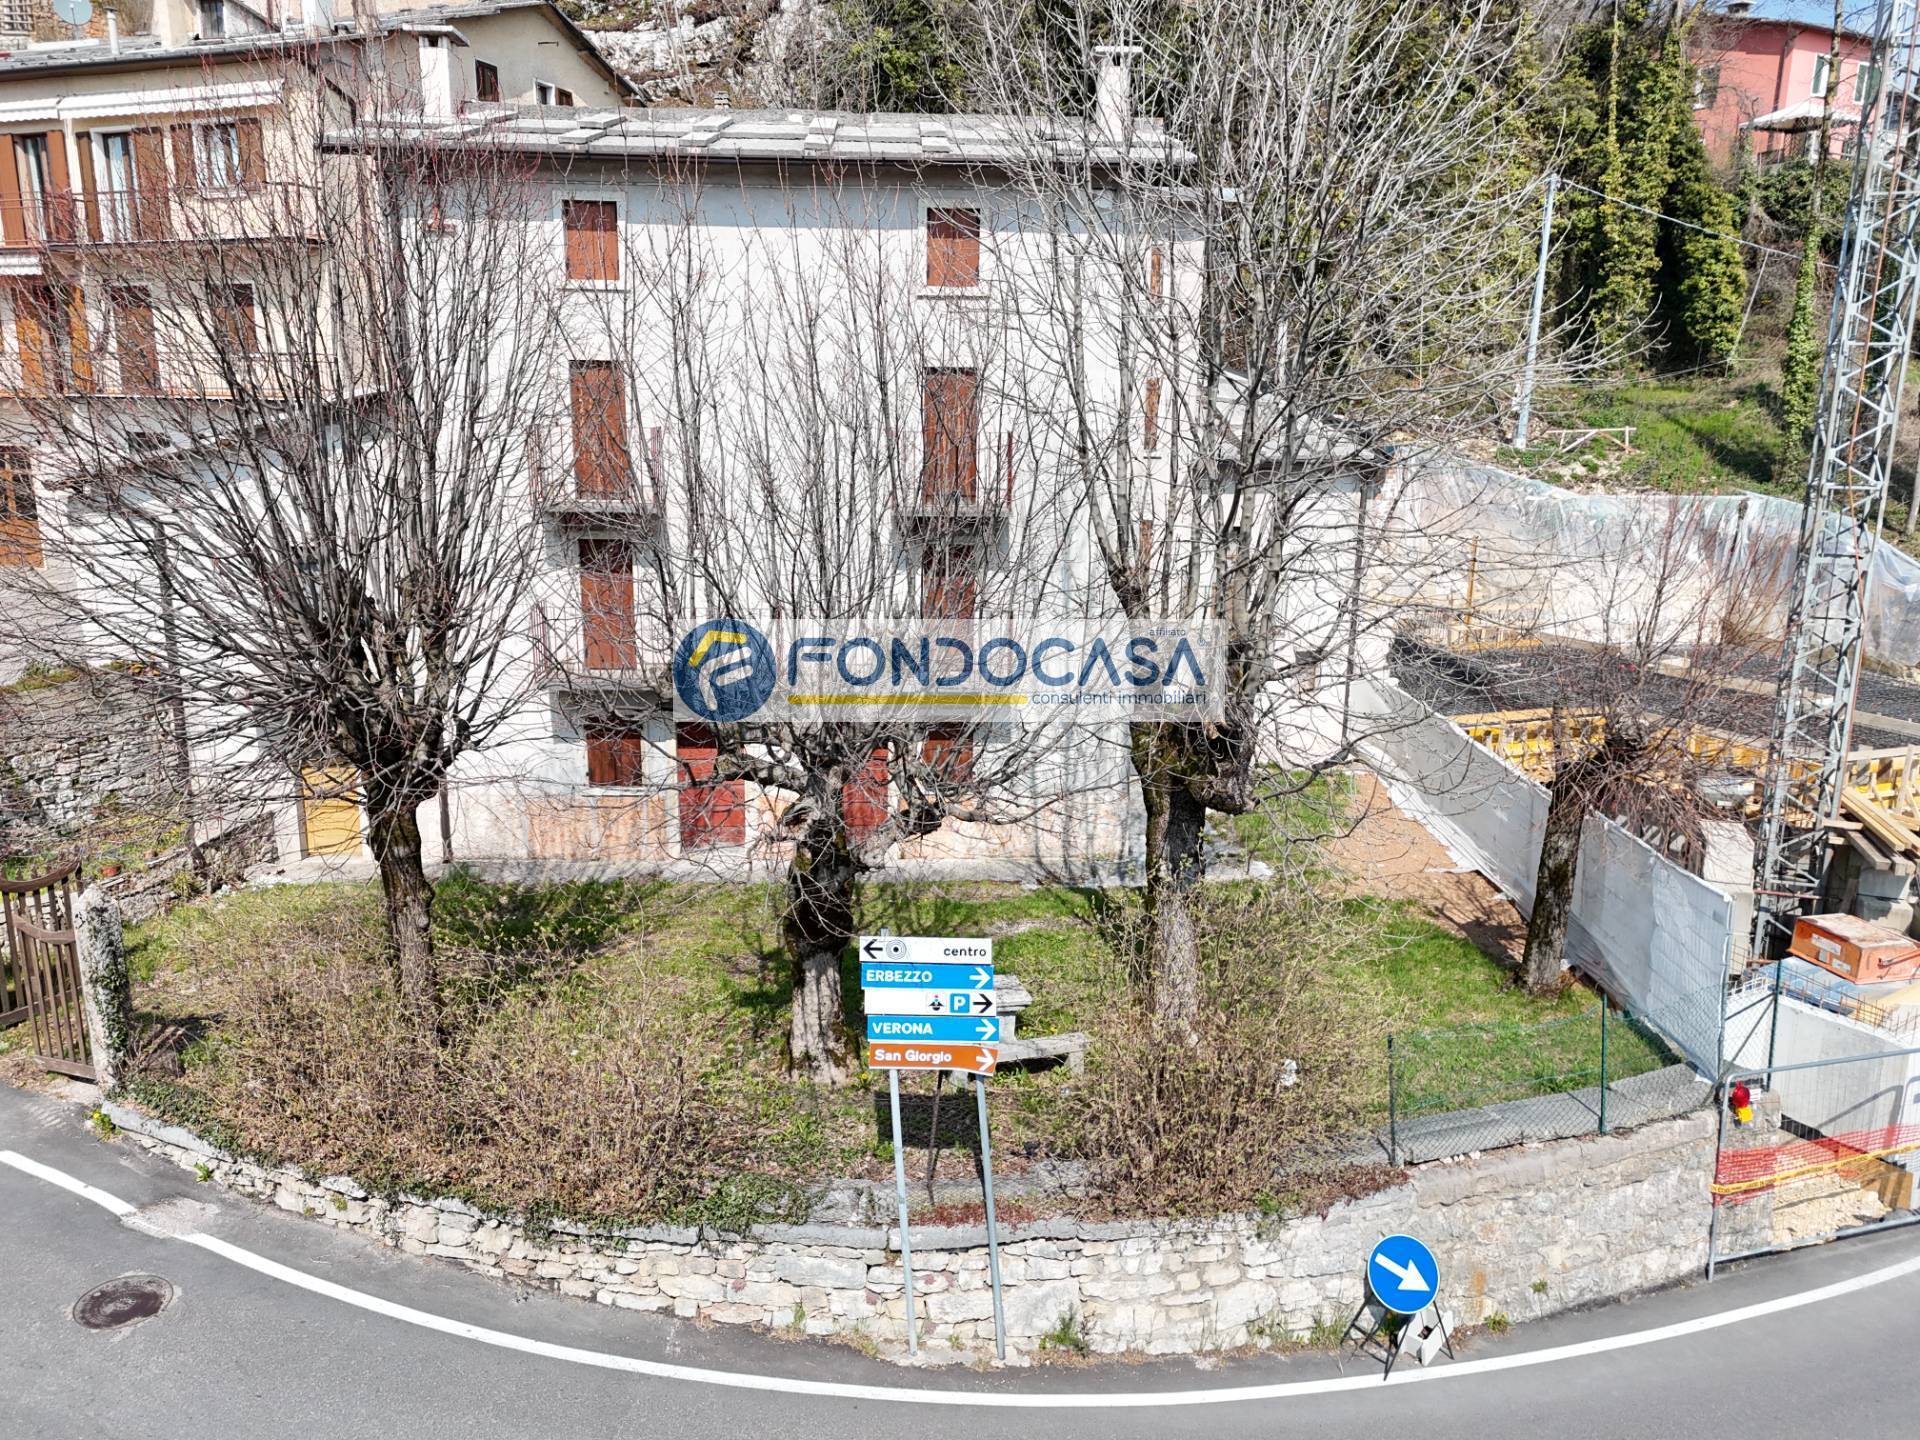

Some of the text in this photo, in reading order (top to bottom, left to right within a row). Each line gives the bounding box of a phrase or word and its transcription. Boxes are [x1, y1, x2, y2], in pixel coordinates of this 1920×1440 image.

[943, 947, 987, 957] centro
[866, 970, 933, 982] ERBEZZO
[953, 996, 966, 1011] P
[872, 1022, 934, 1035] VERONA
[874, 1049, 952, 1064] San Giorgio
